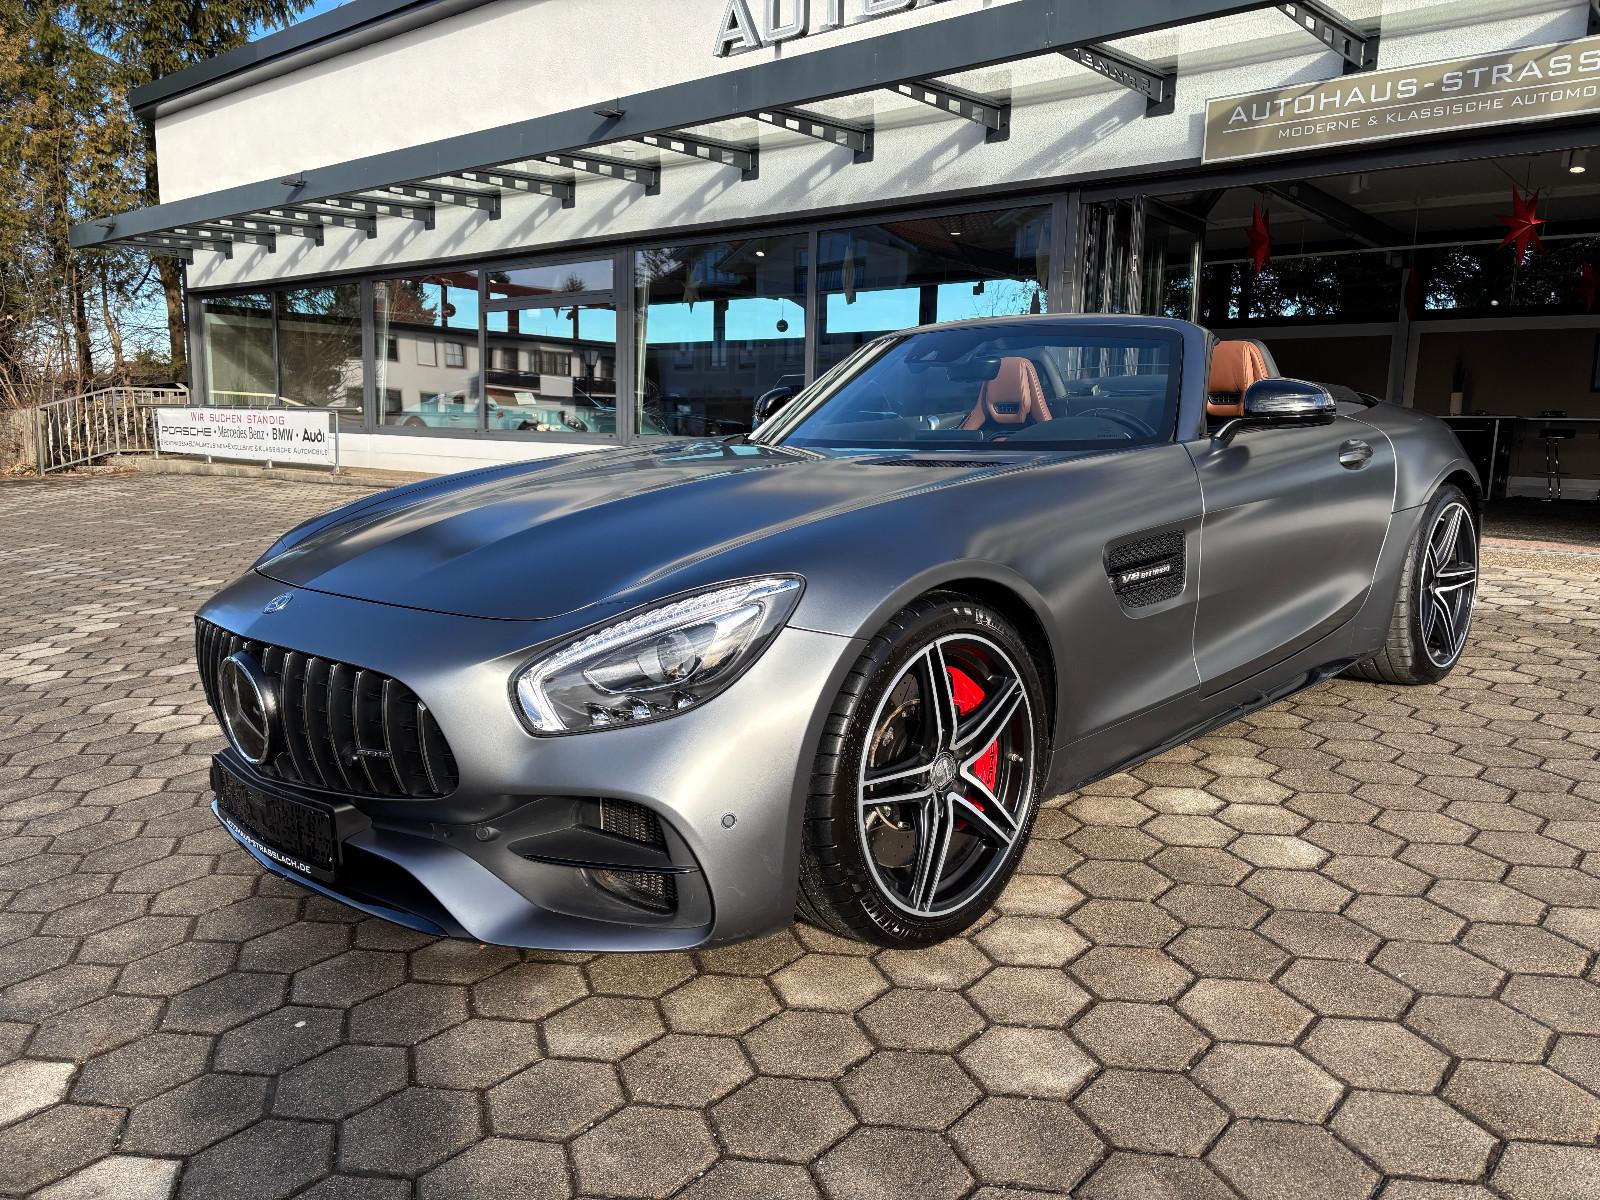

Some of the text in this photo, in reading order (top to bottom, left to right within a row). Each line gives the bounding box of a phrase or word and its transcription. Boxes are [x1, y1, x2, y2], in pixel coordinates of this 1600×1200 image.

[1228, 50, 1600, 125] AUTOHAUS-STRASS
[1278, 85, 1598, 139] MODERNE & KLASSISCHE AUTOMO
[161, 425, 325, 443] PORSCHE Mercedes Benz BMW Audi
[209, 413, 242, 424] SUCHEN
